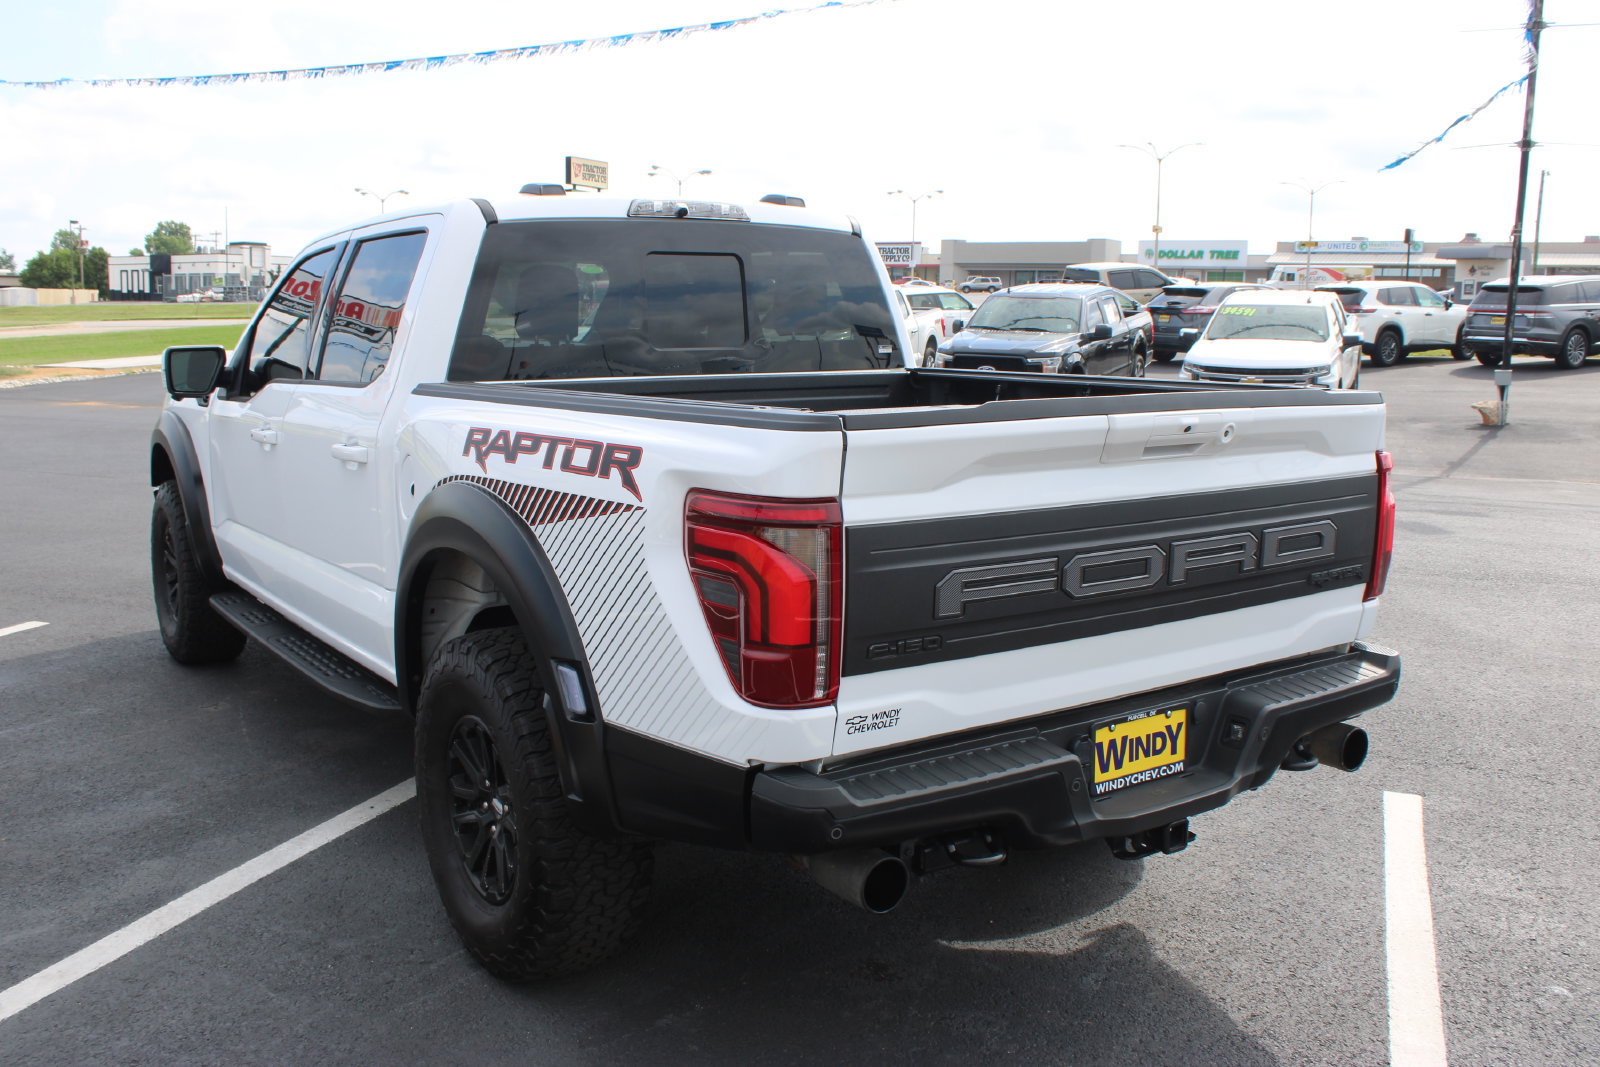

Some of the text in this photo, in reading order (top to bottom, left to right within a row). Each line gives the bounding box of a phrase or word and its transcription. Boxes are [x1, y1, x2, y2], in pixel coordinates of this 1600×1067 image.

[582, 163, 607, 174] TRACTOR
[582, 172, 600, 183] SUPPLY
[1158, 249, 1240, 260] DOLLAR TREE
[1327, 242, 1357, 250] UNITED
[462, 427, 644, 502] RAPTOR
[933, 518, 1338, 620] FORD
[866, 635, 943, 660] F-150
[871, 708, 902, 721] WINDY
[847, 717, 900, 735] CHEVROLET
[1095, 722, 1184, 775] WINDY
[1096, 762, 1184, 795] WINDYCHEV.COM
